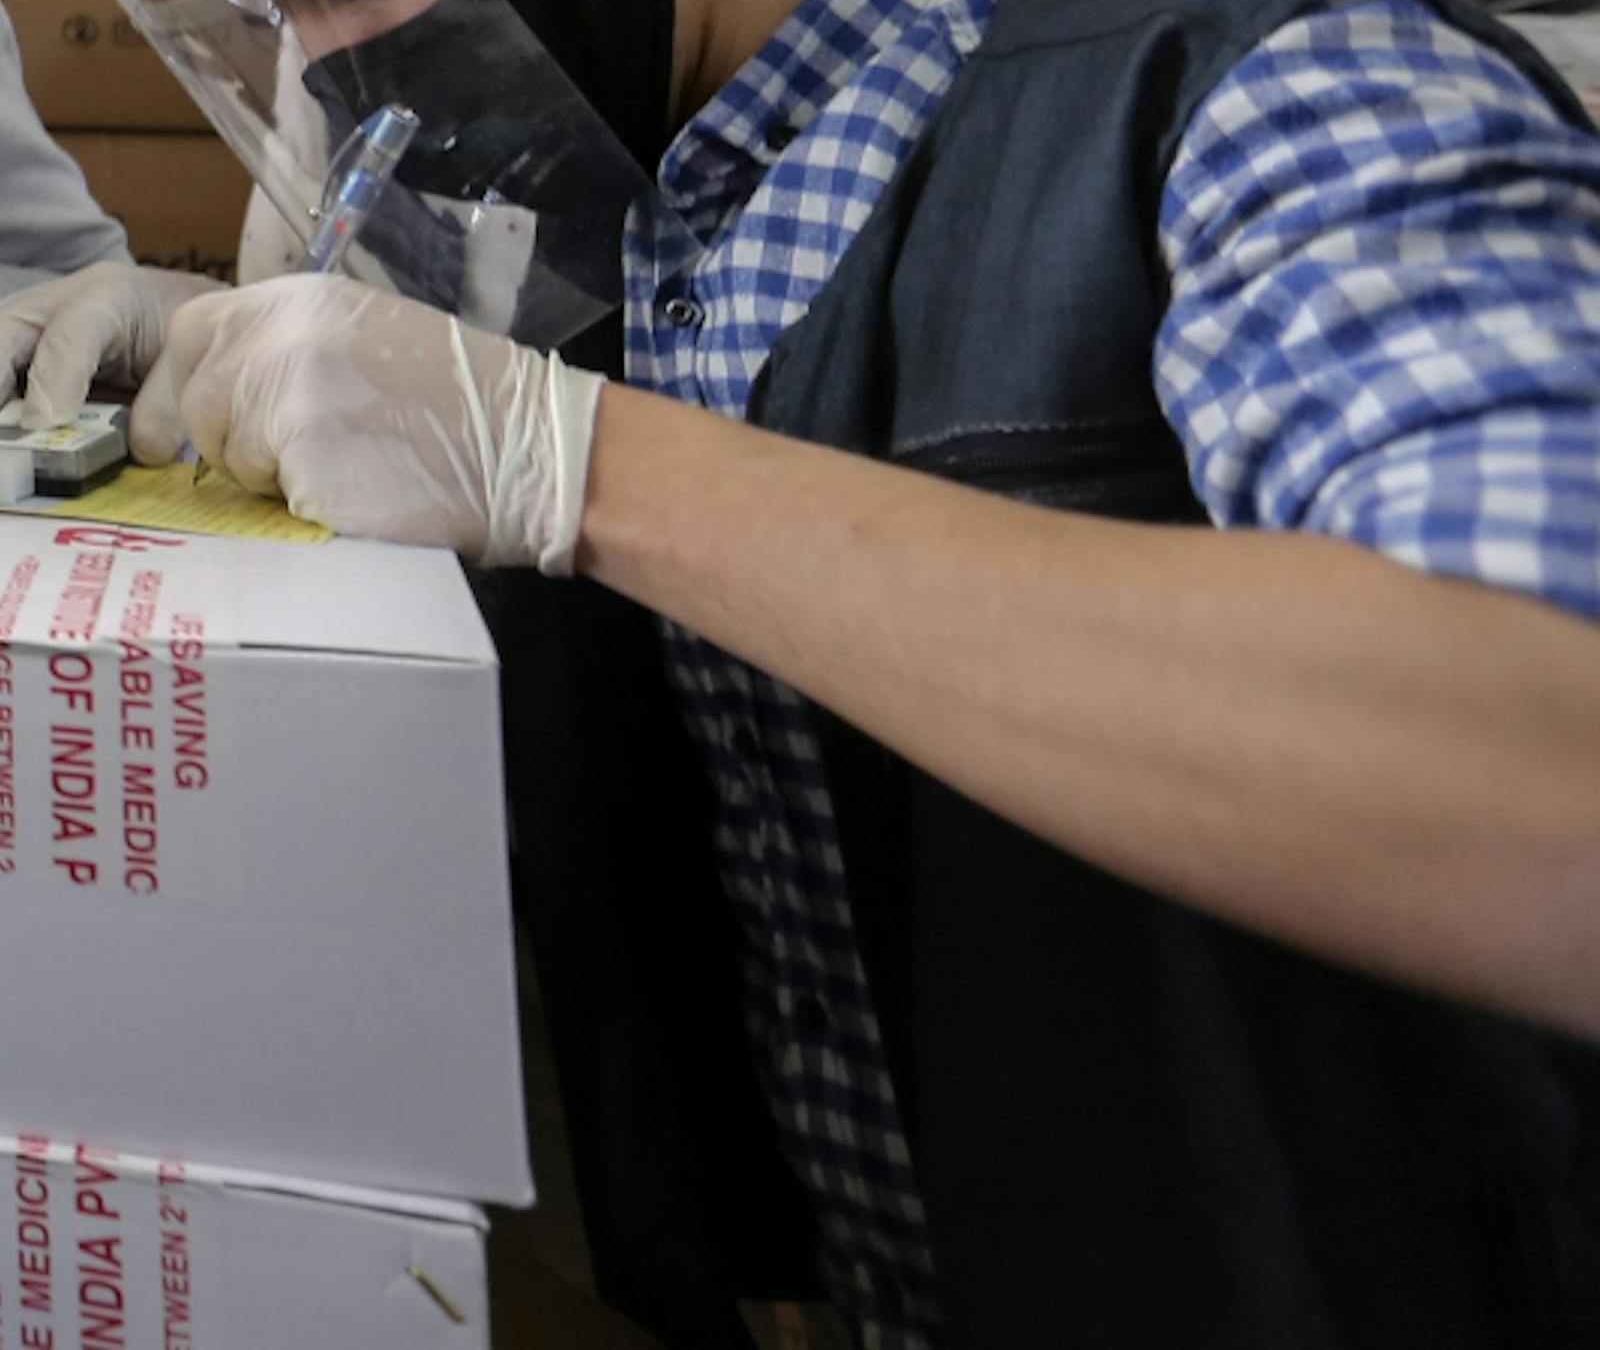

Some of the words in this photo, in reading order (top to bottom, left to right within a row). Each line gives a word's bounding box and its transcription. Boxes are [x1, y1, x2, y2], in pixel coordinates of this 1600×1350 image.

[49, 652, 95, 715] OF
[50, 724, 97, 842] INDIA
[53, 857, 98, 886] P
[160, 1230, 192, 1350] ETWEEN
